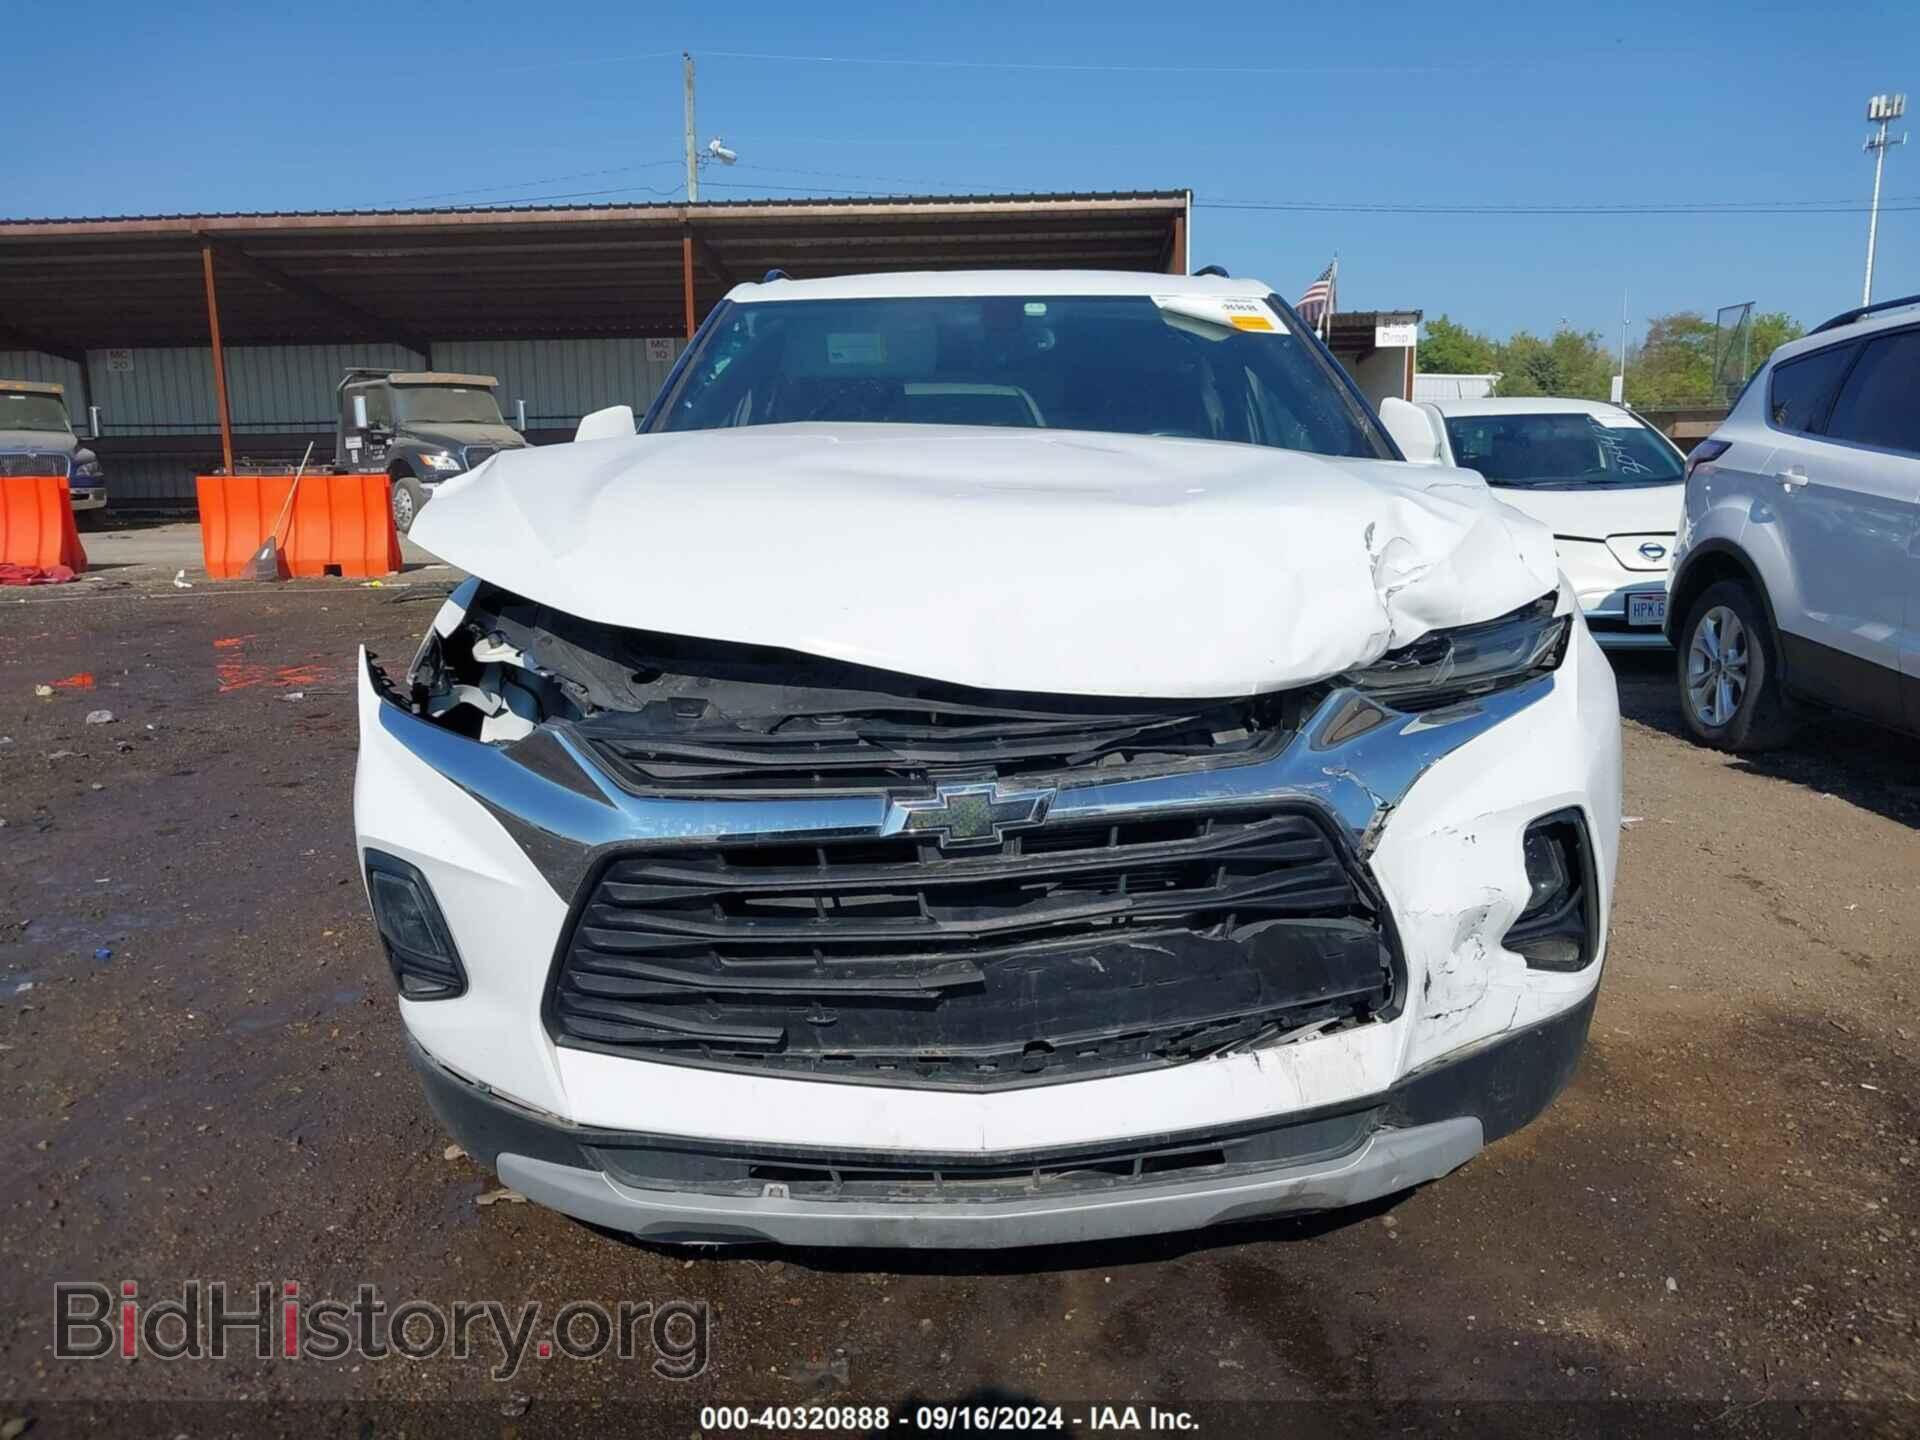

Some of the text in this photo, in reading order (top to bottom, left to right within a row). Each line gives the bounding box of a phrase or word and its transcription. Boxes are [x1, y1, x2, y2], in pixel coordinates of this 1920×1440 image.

[651, 339, 670, 348] MC
[1383, 332, 1408, 345] Drop
[110, 350, 128, 360] MC
[1633, 602, 1654, 617] HPK
